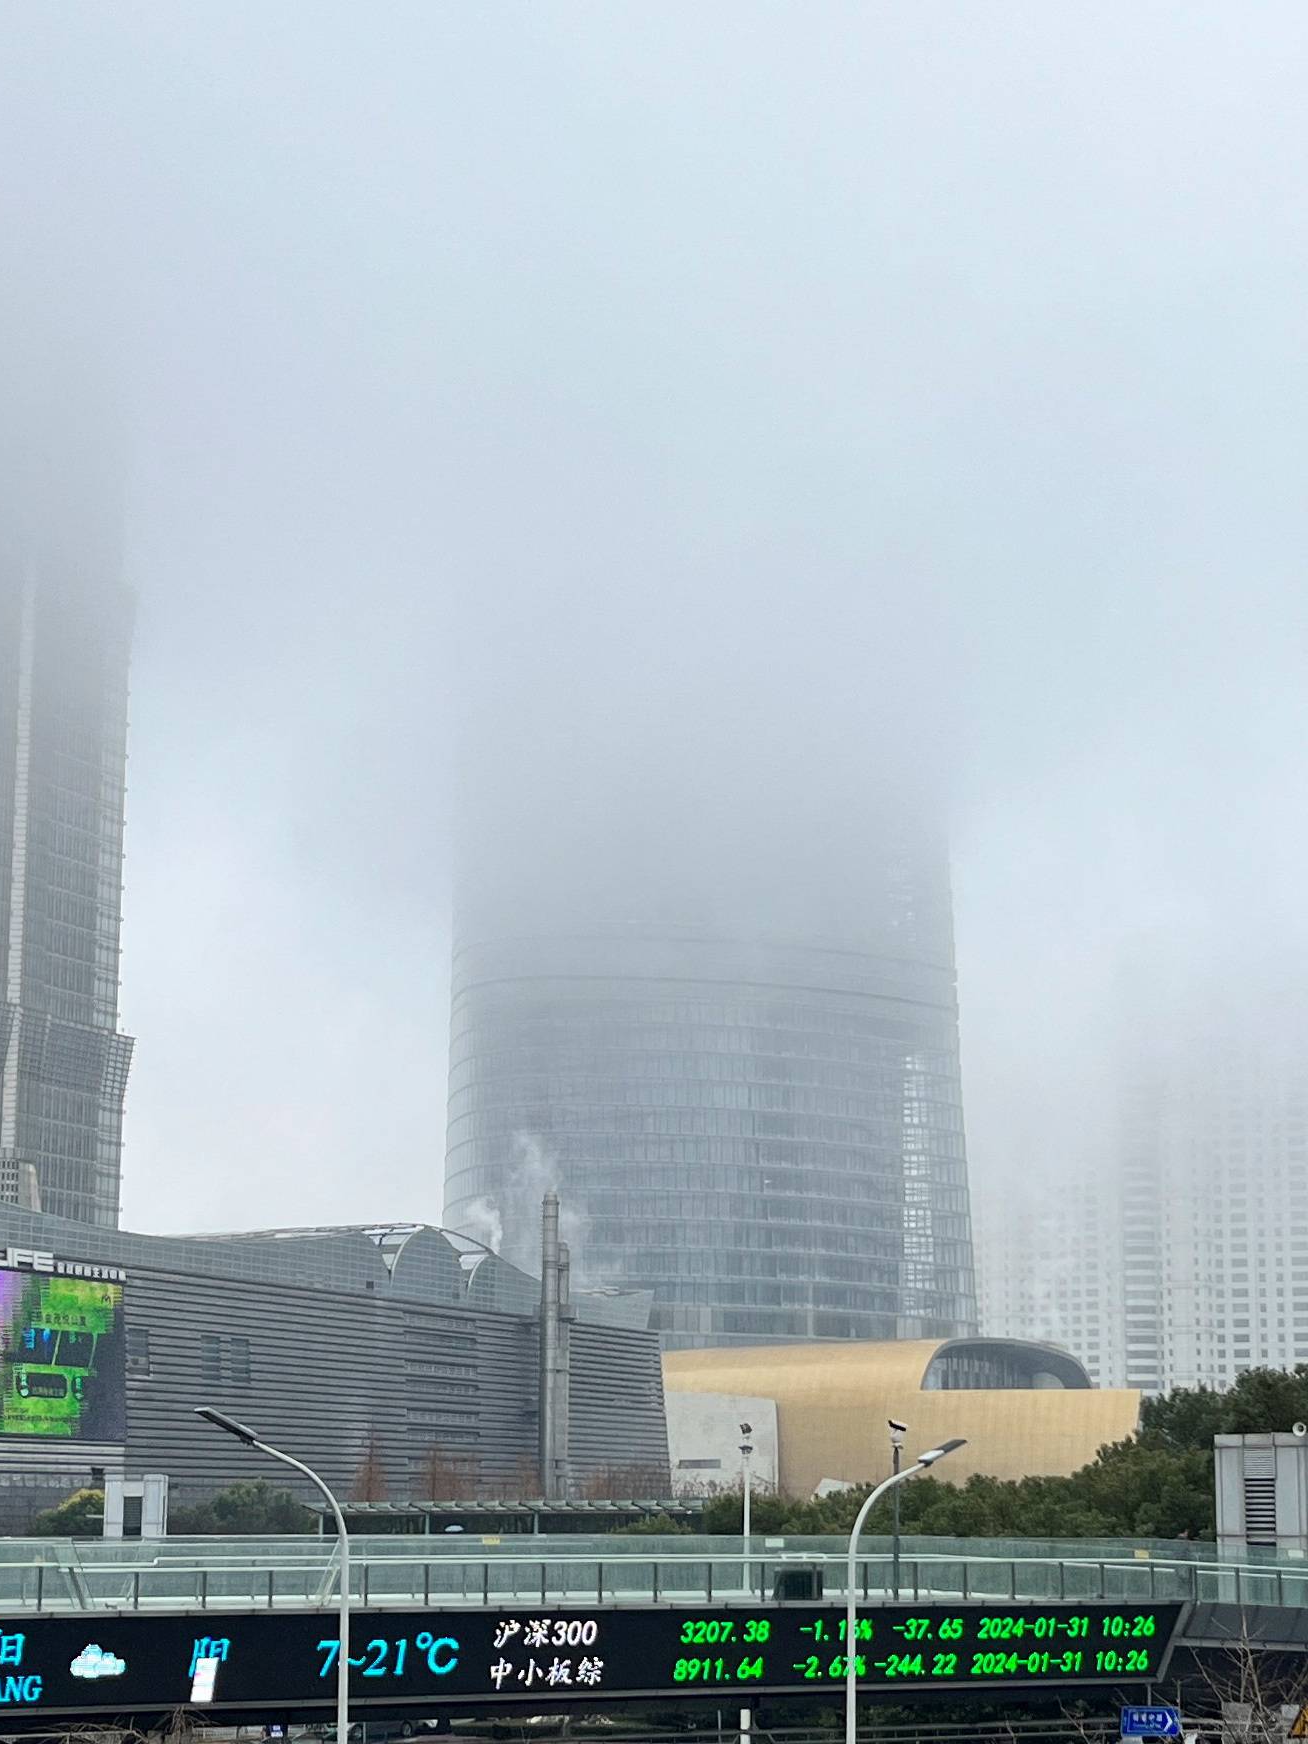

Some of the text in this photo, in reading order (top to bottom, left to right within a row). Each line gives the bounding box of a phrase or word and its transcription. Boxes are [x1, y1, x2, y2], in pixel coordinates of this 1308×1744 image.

[493, 1619, 598, 1648] 沪深300
[681, 1619, 771, 1643] 3207.38
[892, 1617, 964, 1640] -37.65
[977, 1616, 1089, 1639] 2024-01-31
[1102, 1615, 1155, 1637] 10:26
[490, 1656, 604, 1690] 中小板综
[673, 1656, 764, 1682] 8911.64
[874, 1653, 958, 1676] -244.22
[971, 1650, 1083, 1675] 2024-01-31
[1095, 1649, 1149, 1672] 10:26
